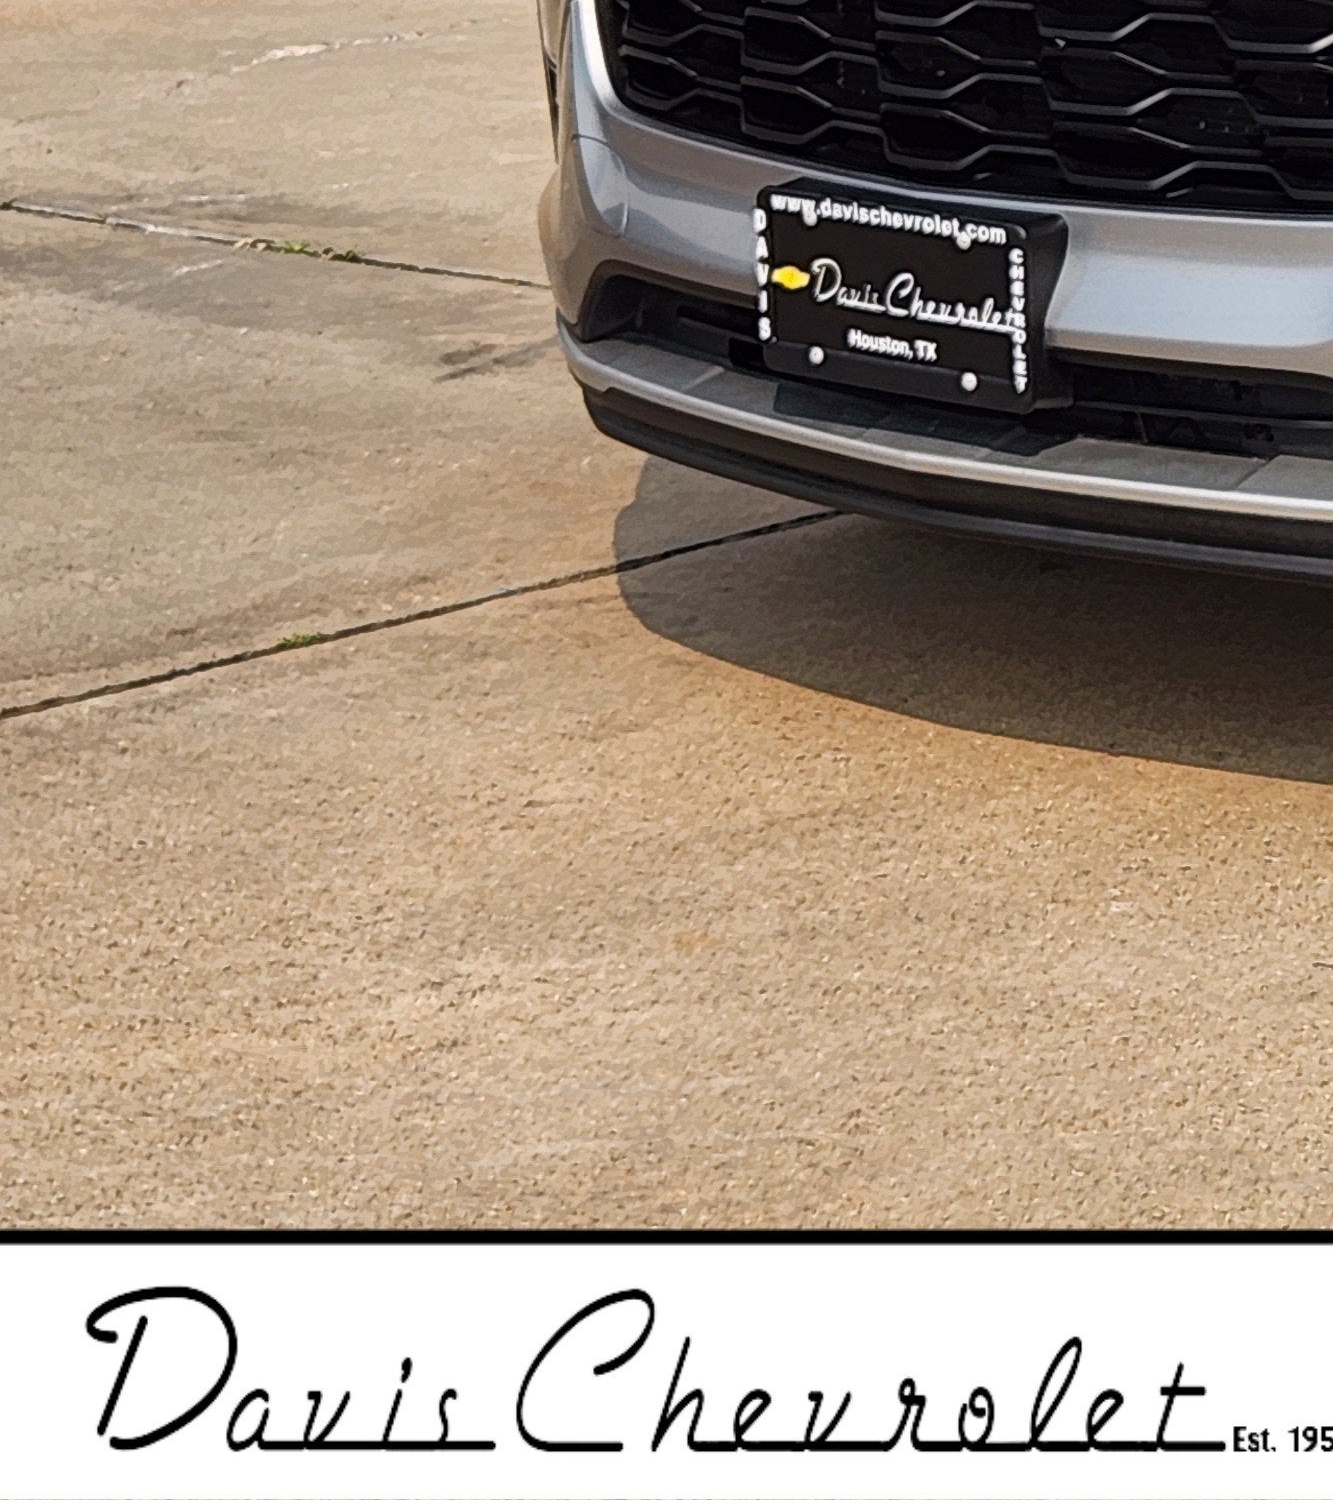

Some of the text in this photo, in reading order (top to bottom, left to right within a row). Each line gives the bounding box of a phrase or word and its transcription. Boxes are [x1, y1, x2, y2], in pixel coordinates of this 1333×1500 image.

[809, 257, 1018, 334] Davis Chevrolet
[847, 328, 938, 363] Houston, TX
